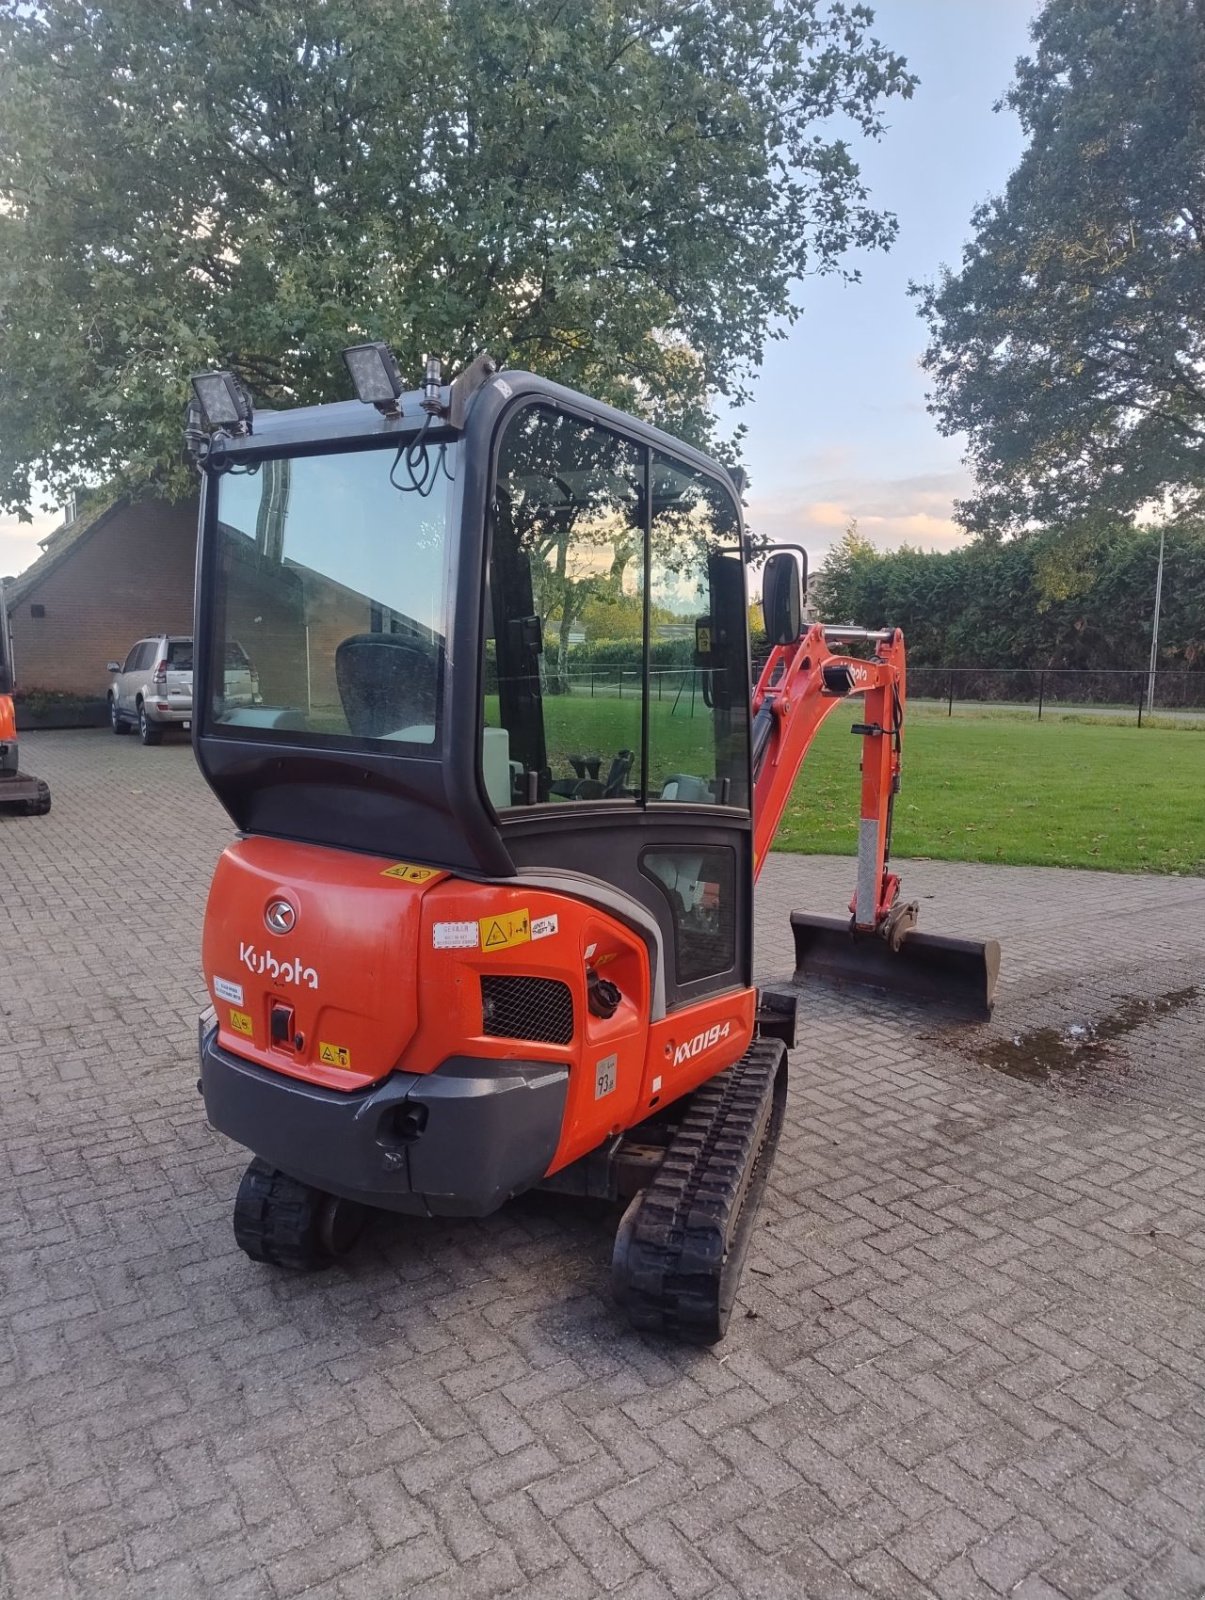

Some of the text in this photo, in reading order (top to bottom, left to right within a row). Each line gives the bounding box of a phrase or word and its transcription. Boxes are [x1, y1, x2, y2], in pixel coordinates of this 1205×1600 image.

[239, 941, 318, 989] Kubota
[673, 1021, 730, 1067] KX019-4
[598, 1073, 609, 1095] 93
